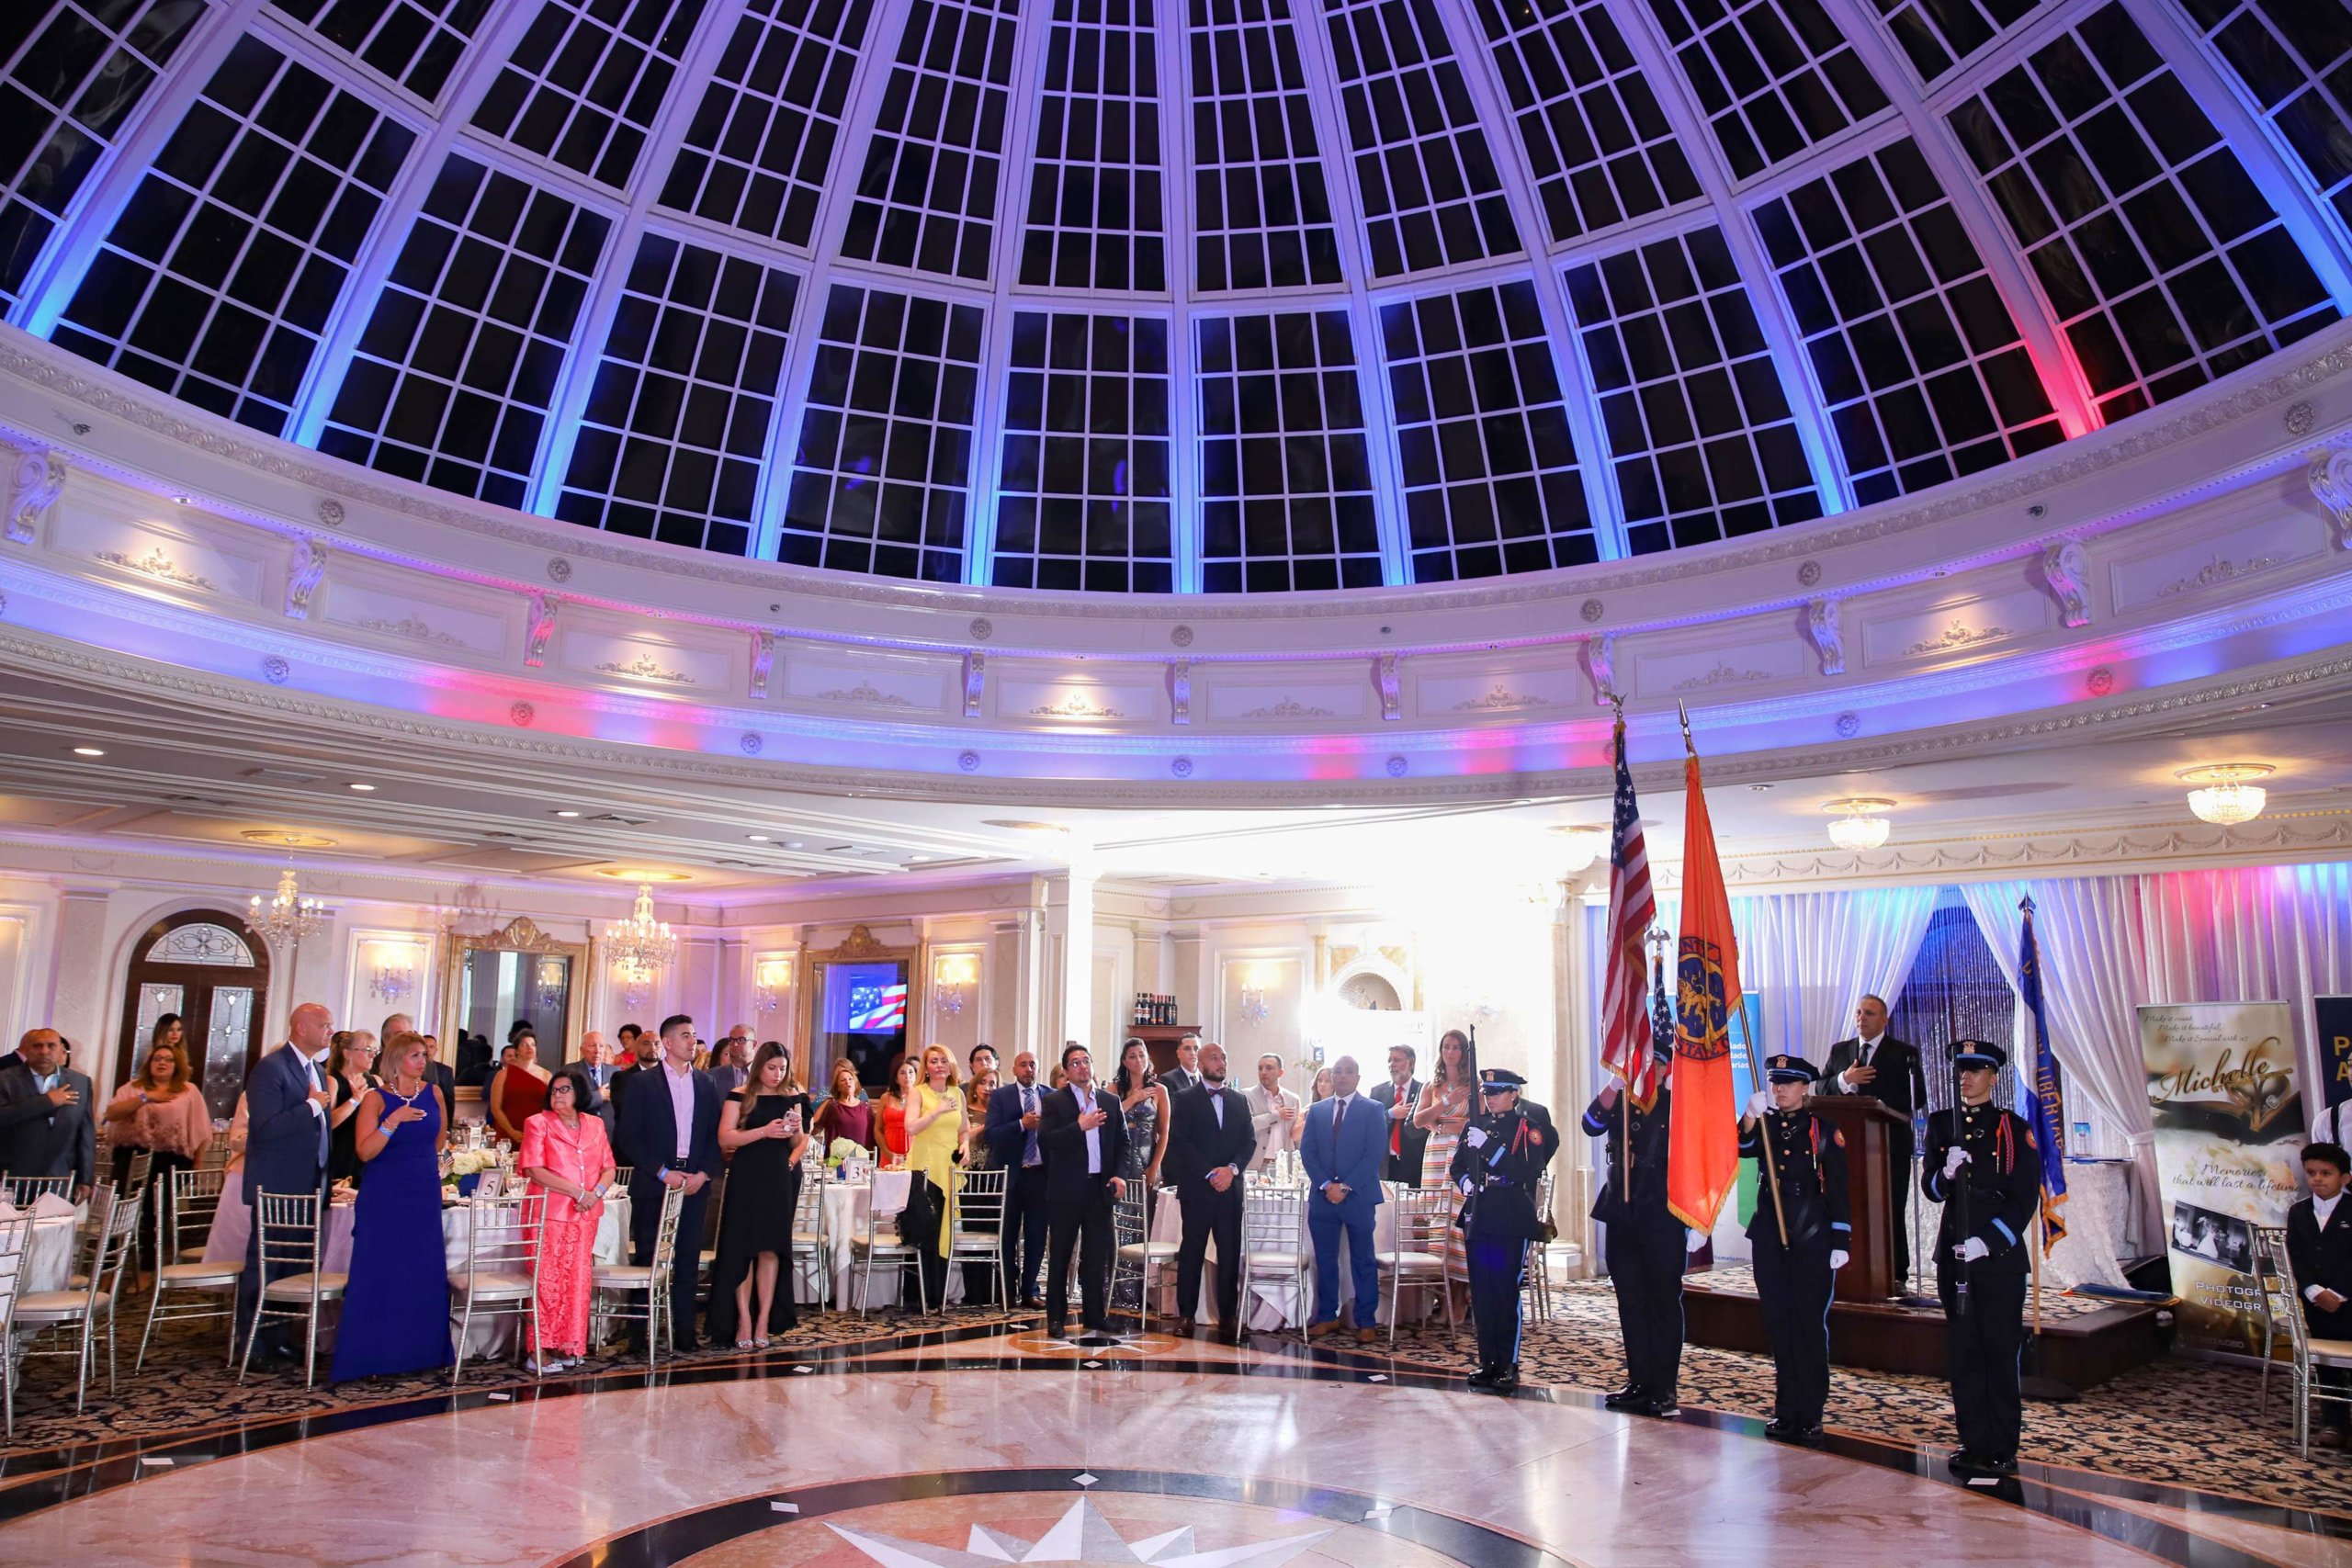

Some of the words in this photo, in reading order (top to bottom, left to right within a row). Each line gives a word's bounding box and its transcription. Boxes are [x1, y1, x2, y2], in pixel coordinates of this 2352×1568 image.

[2144, 1015, 2166, 1023] Make
[2164, 1034, 2186, 1043] Make
[2194, 1034, 2222, 1044] Special
[2151, 1036, 2280, 1103] Michelle
[852, 1167, 860, 1179] 3
[2201, 1163, 2264, 1178] Memories
[484, 1180, 496, 1195] 5
[2173, 1175, 2194, 1185] that
[2197, 1177, 2219, 1187] will
[2222, 1177, 2243, 1189] last
